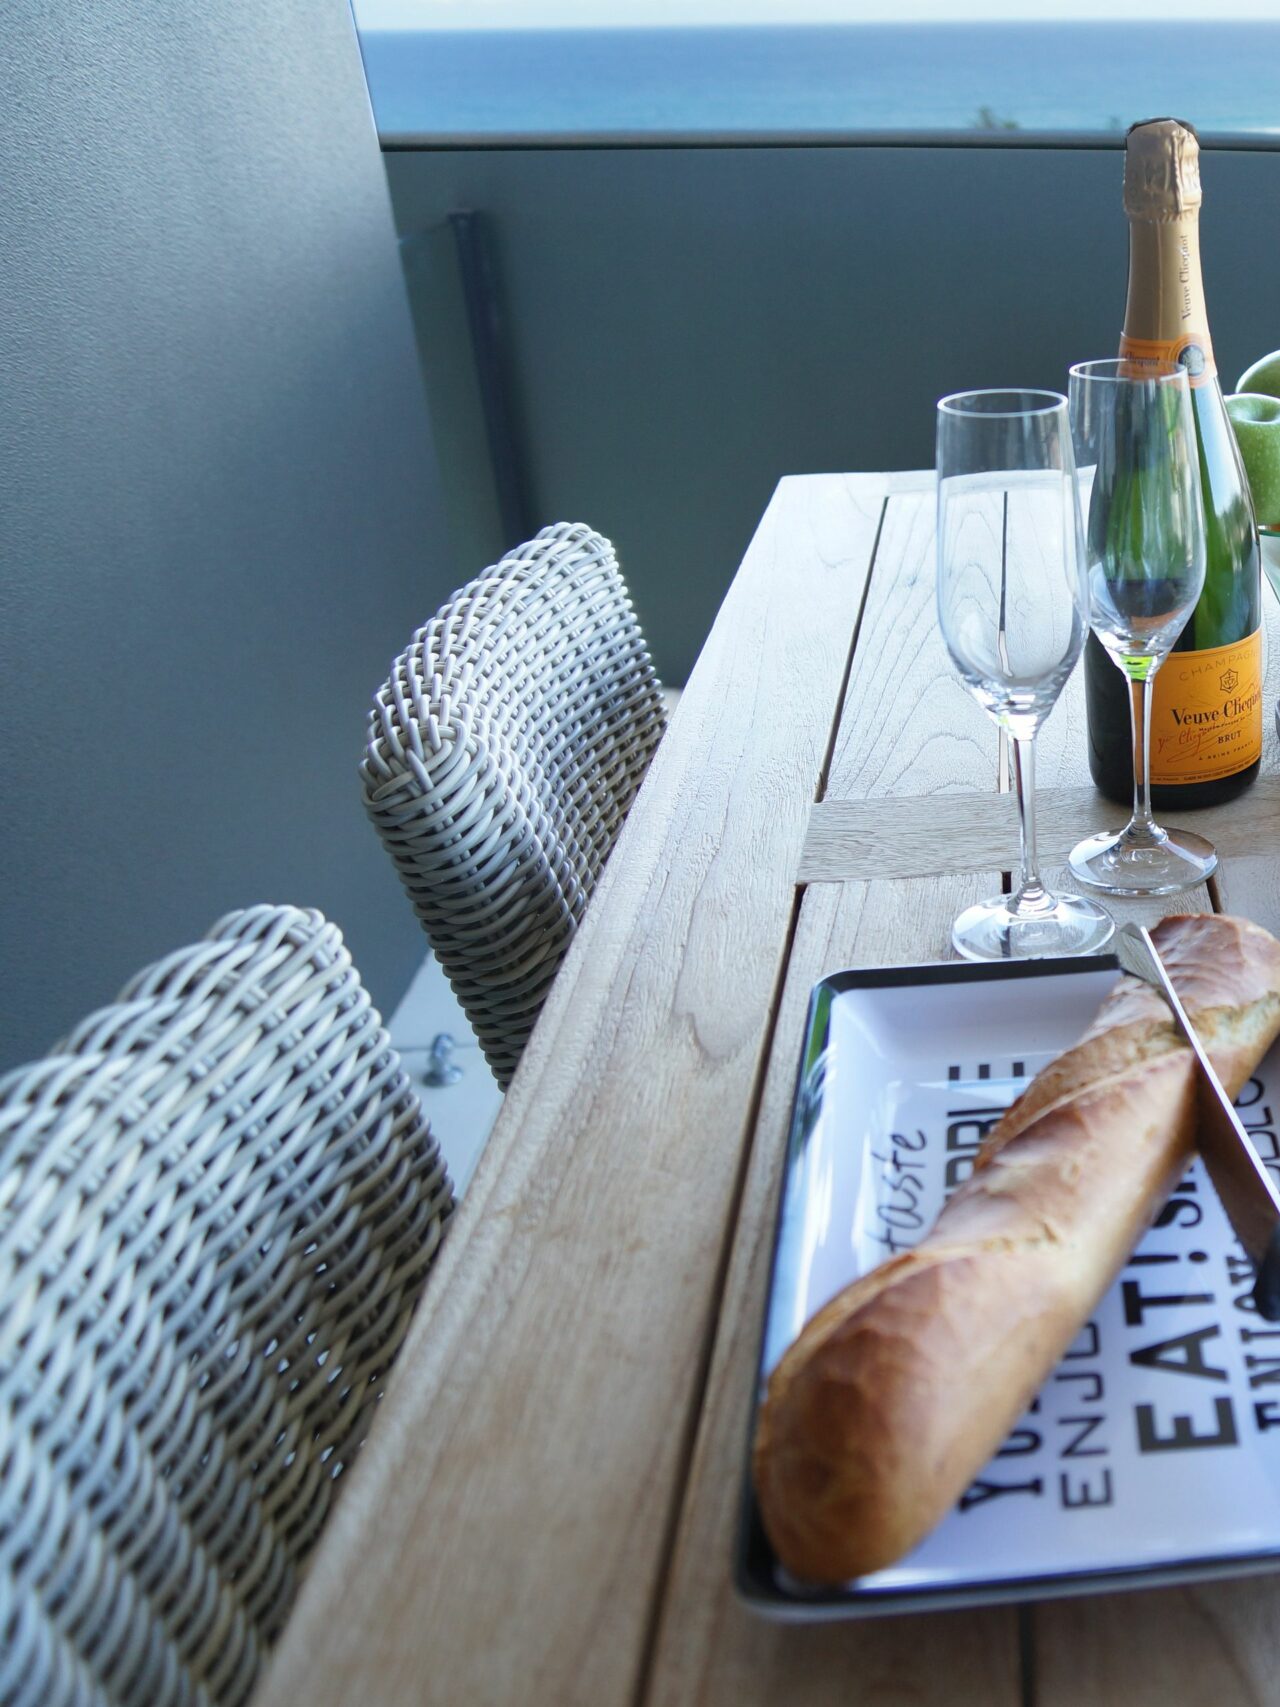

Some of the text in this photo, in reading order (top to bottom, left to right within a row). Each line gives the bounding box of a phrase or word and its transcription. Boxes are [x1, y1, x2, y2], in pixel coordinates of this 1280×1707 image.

[1171, 707, 1220, 727] Veuve
[1217, 730, 1241, 744] BRUT
[1121, 1250, 1239, 1454] EAT!
